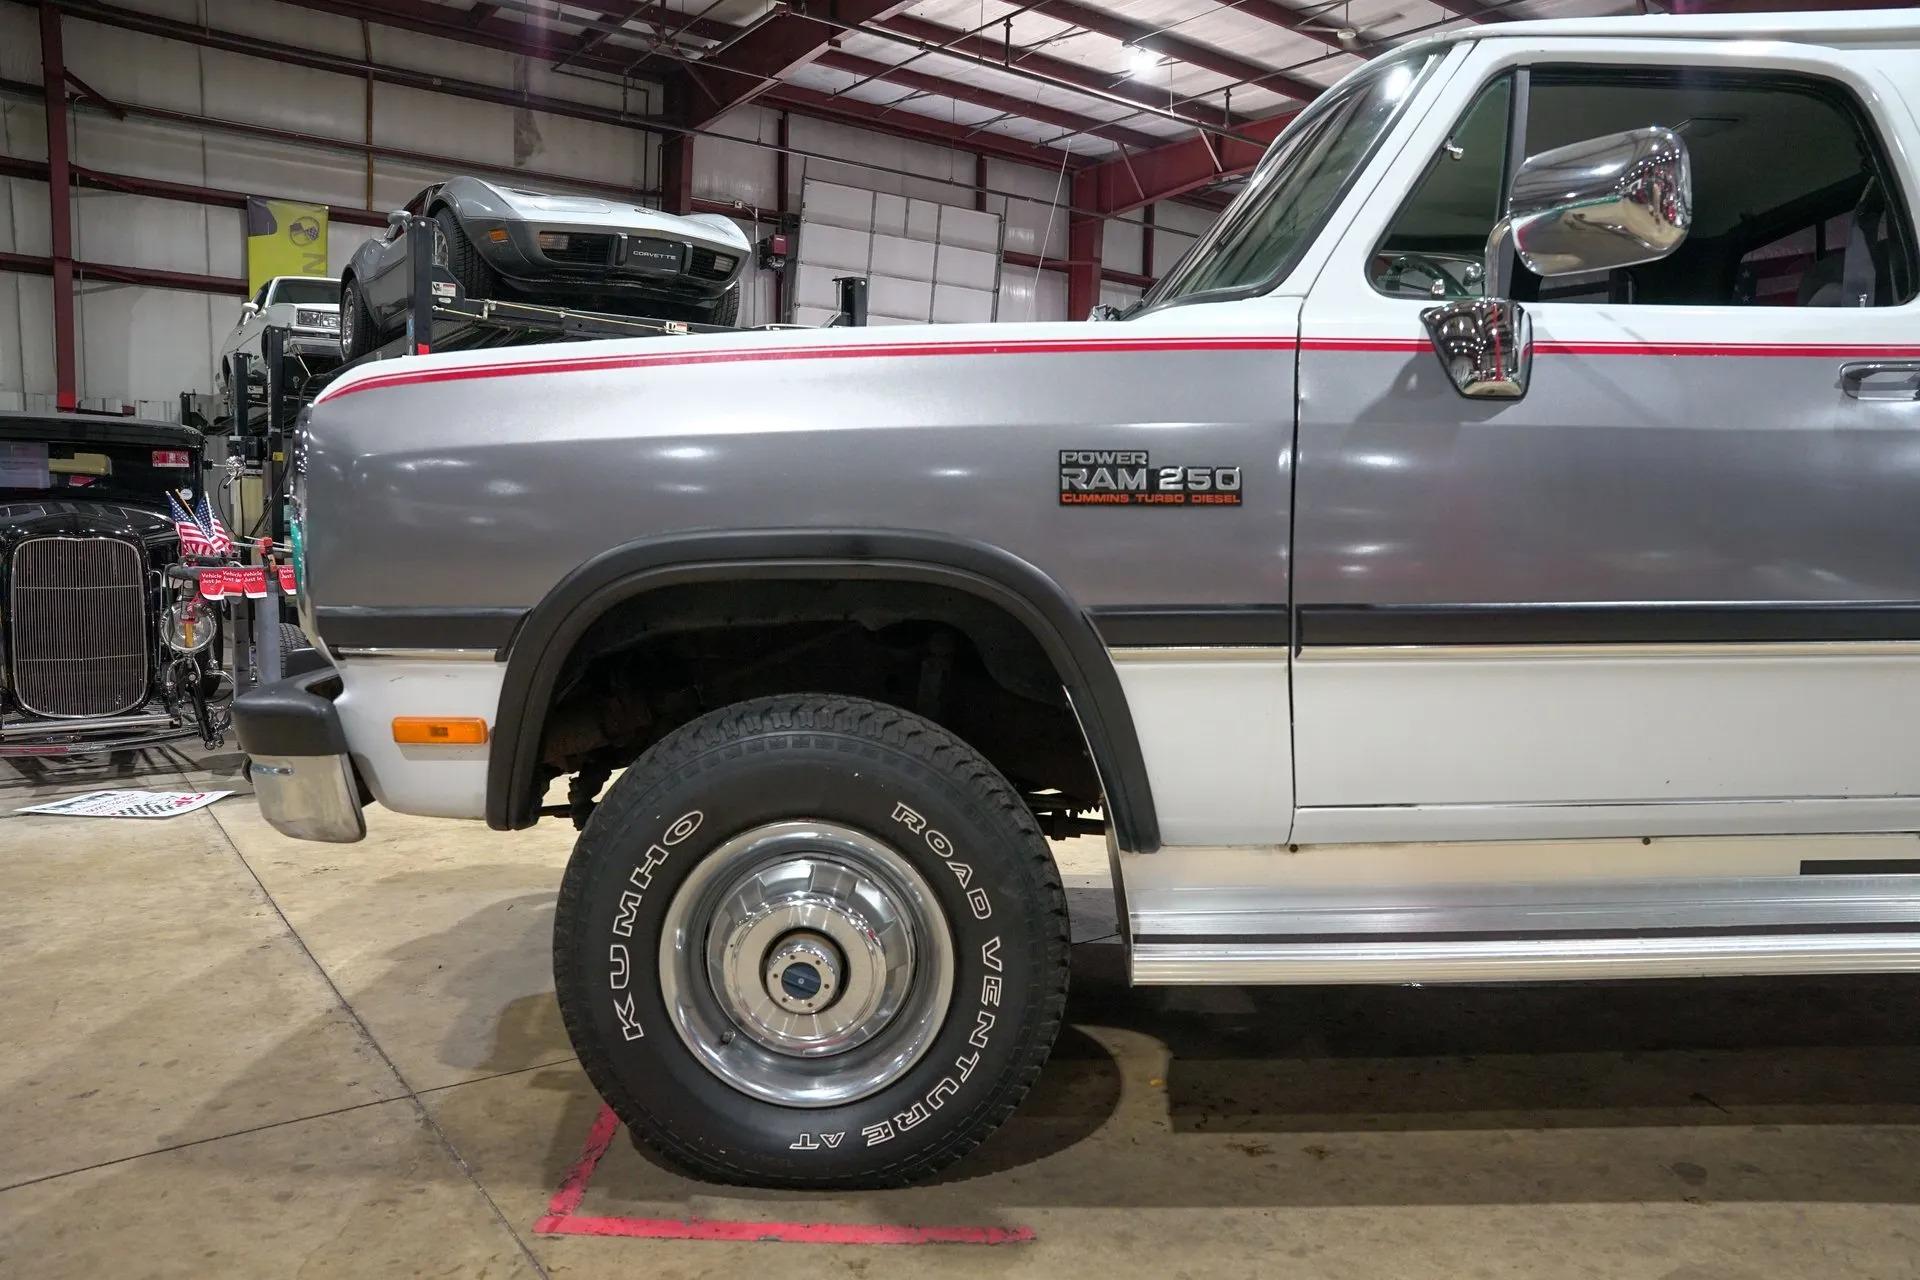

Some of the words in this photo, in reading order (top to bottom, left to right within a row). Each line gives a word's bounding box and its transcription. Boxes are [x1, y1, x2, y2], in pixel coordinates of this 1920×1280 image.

[632, 250, 677, 260] CORVETTE
[1061, 451, 1148, 465] POWER
[1061, 467, 1147, 490] RAM
[1158, 466, 1241, 491] 250
[1062, 493, 1129, 503] CUMMINS
[1135, 493, 1185, 503] TURBO
[1191, 493, 1241, 503] DIESEL
[890, 801, 992, 921] ROAD
[608, 809, 704, 1042] KUMHO
[861, 936, 1004, 1148] VENTURE
[789, 1131, 846, 1150] AT
